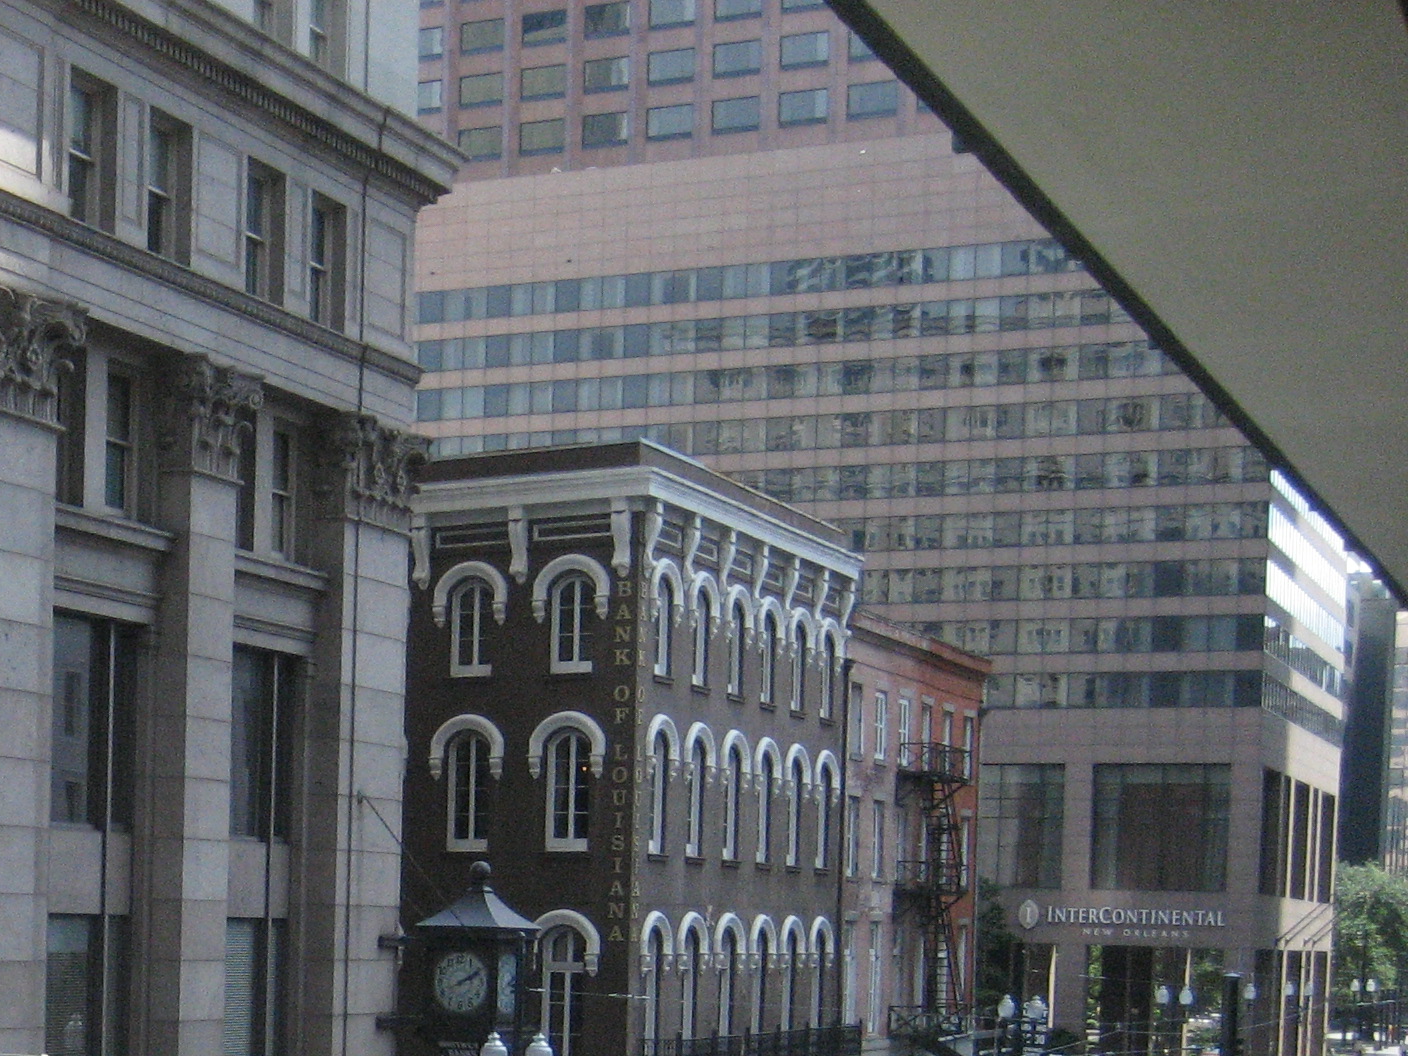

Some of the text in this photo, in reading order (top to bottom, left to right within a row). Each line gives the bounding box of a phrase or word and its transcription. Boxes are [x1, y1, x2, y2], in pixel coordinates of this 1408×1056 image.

[607, 580, 632, 942] BANK OF LOUISIANA
[1081, 927, 1190, 938] NEW ORLEANS
